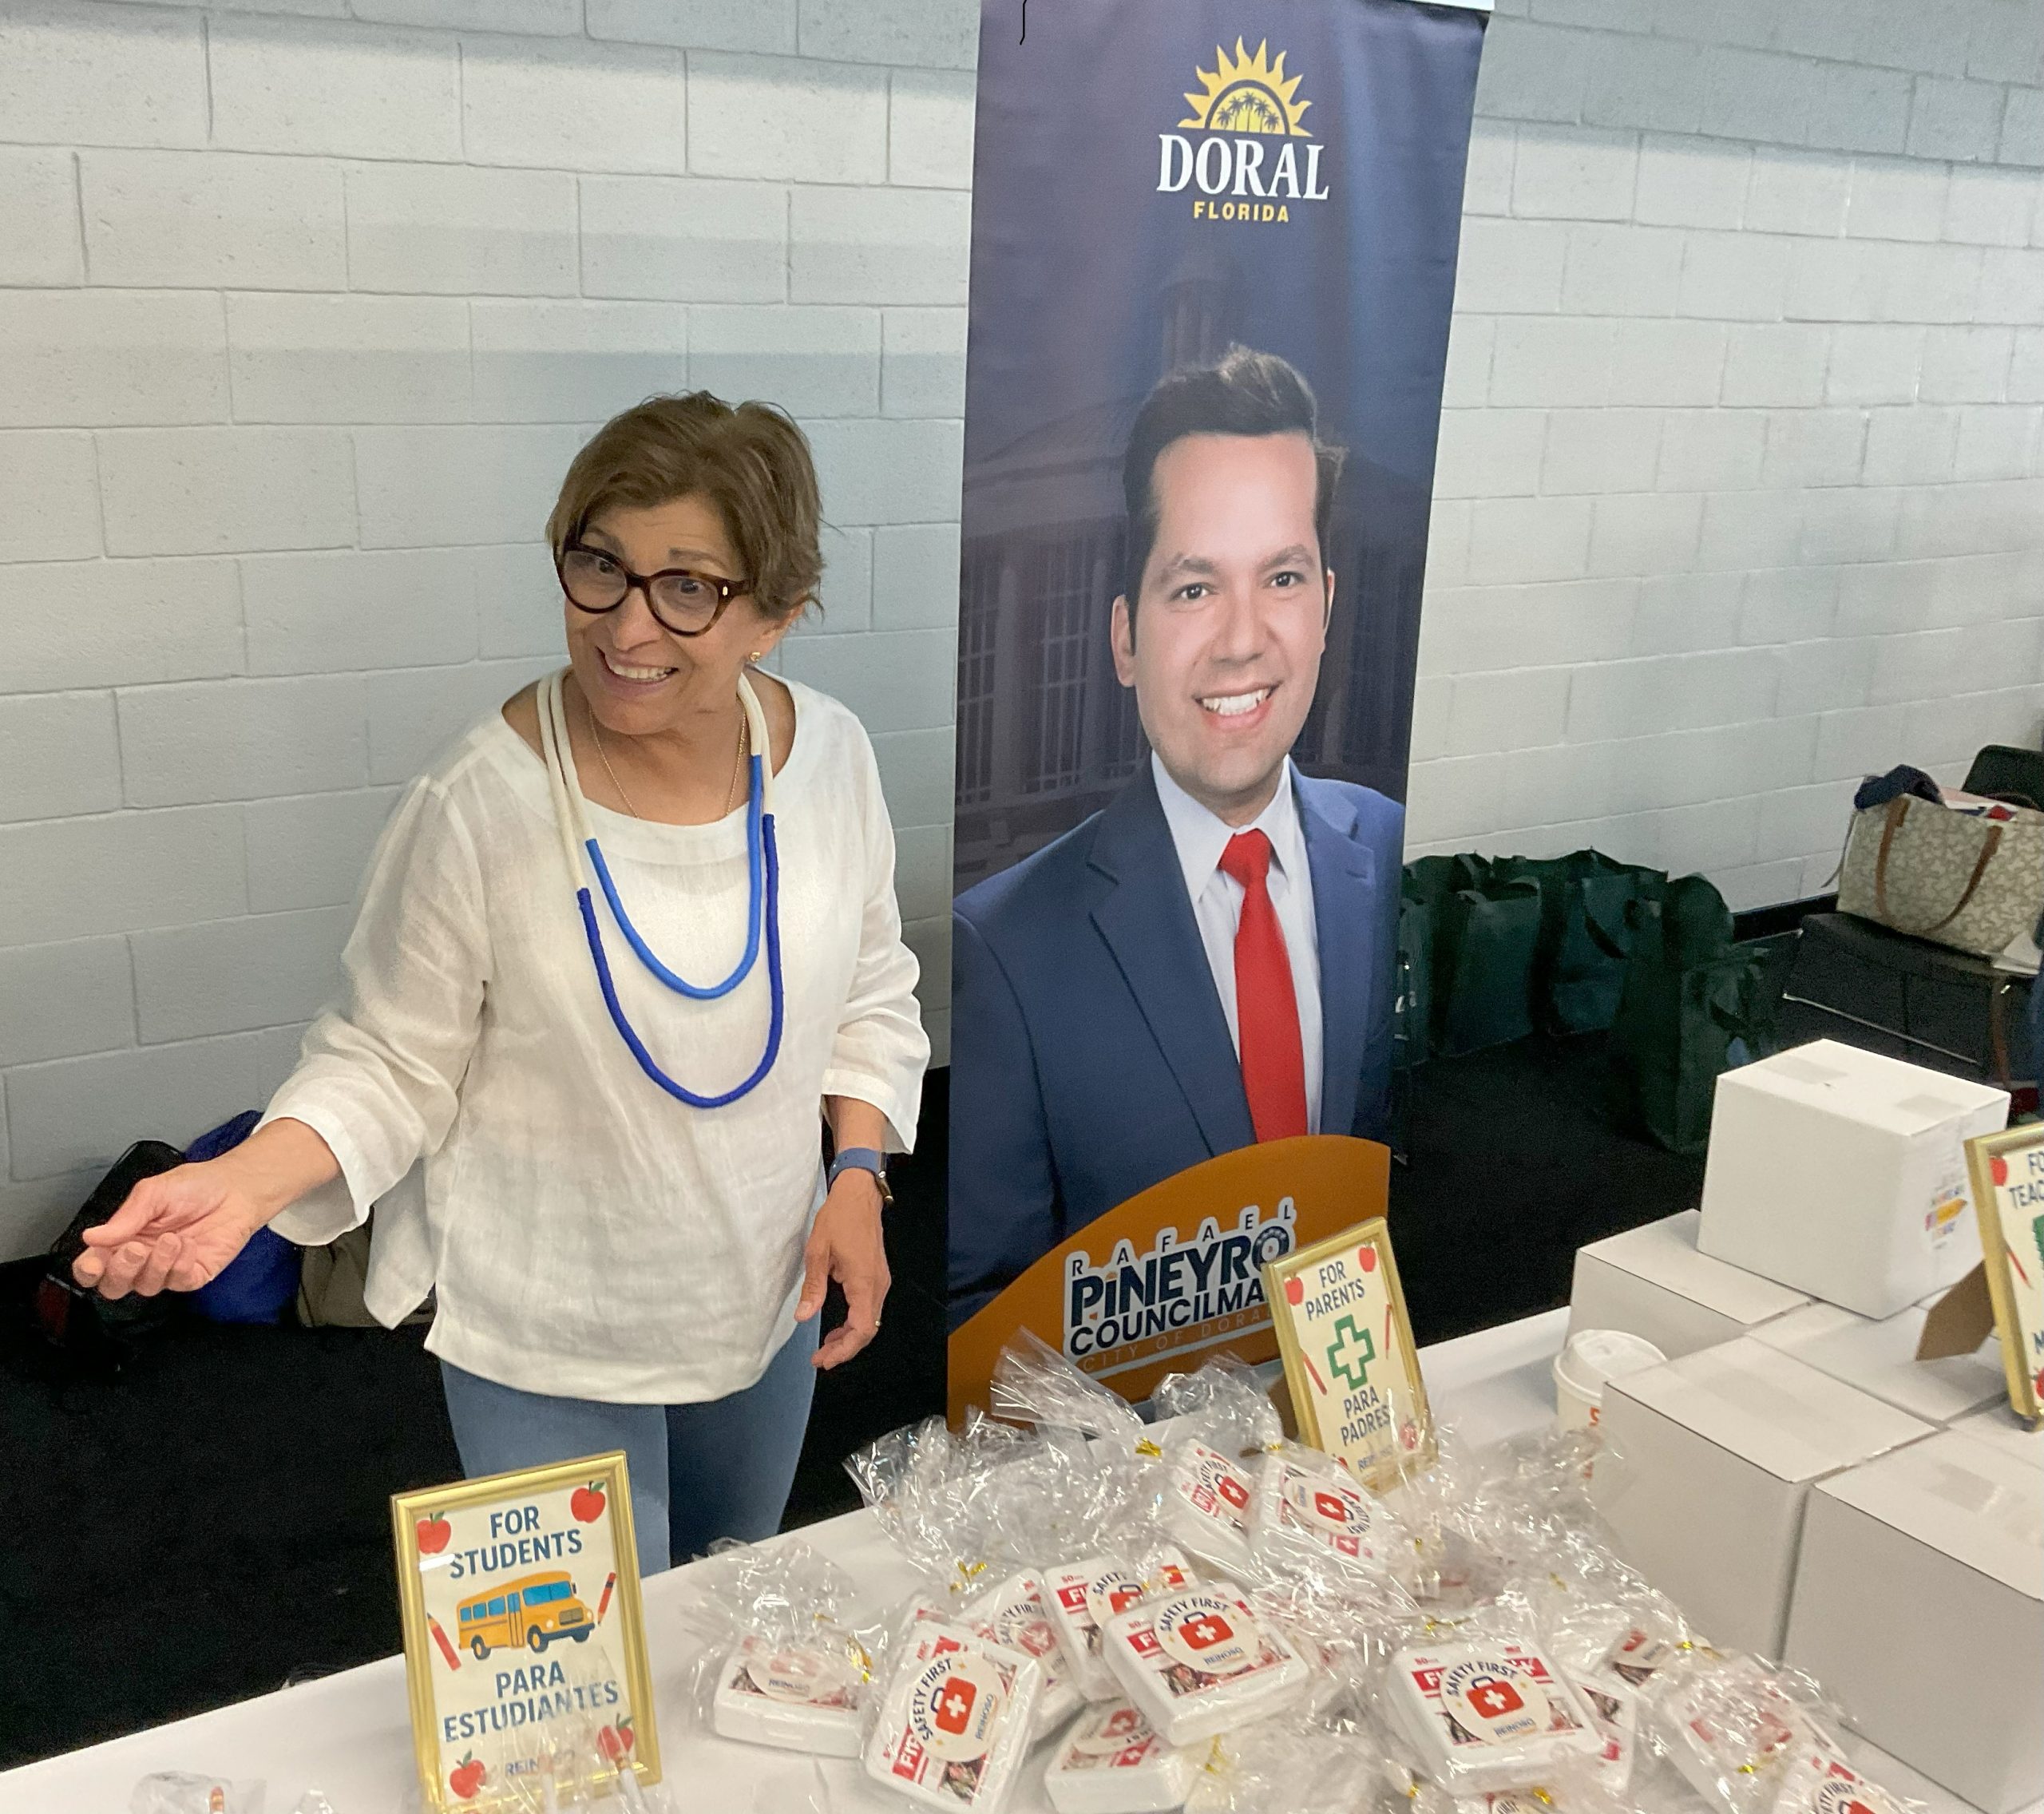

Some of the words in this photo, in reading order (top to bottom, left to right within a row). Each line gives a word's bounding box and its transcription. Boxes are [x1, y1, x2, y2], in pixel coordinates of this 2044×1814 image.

[1157, 134, 1329, 200] DORAL
[1194, 200, 1289, 223] FLORIDA
[1072, 1204, 1291, 1276] RAFAEL
[1320, 1260, 1347, 1289] FOR
[1071, 1277, 1266, 1356] COUNCILMA
[1305, 1278, 1365, 1321] PARENTS
[1083, 1344, 1137, 1372] CITY
[1156, 1331, 1182, 1350] OF
[1202, 1309, 1270, 1337] DORA
[1344, 1384, 1380, 1418] PARA
[1341, 1404, 1391, 1448] PADRES
[490, 1506, 541, 1539] FOR
[450, 1528, 583, 1579] STUDENTS
[1160, 1599, 1189, 1632] SAFETY
[1190, 1597, 1230, 1612] FIRST
[496, 1660, 566, 1699] PARA
[921, 1658, 953, 1689] FIRST
[1446, 1661, 1476, 1697] SAFETY
[1476, 1661, 1519, 1680] FIRST
[444, 1680, 620, 1743] ESTUDIANTES
[913, 1688, 934, 1741] SAFETY
